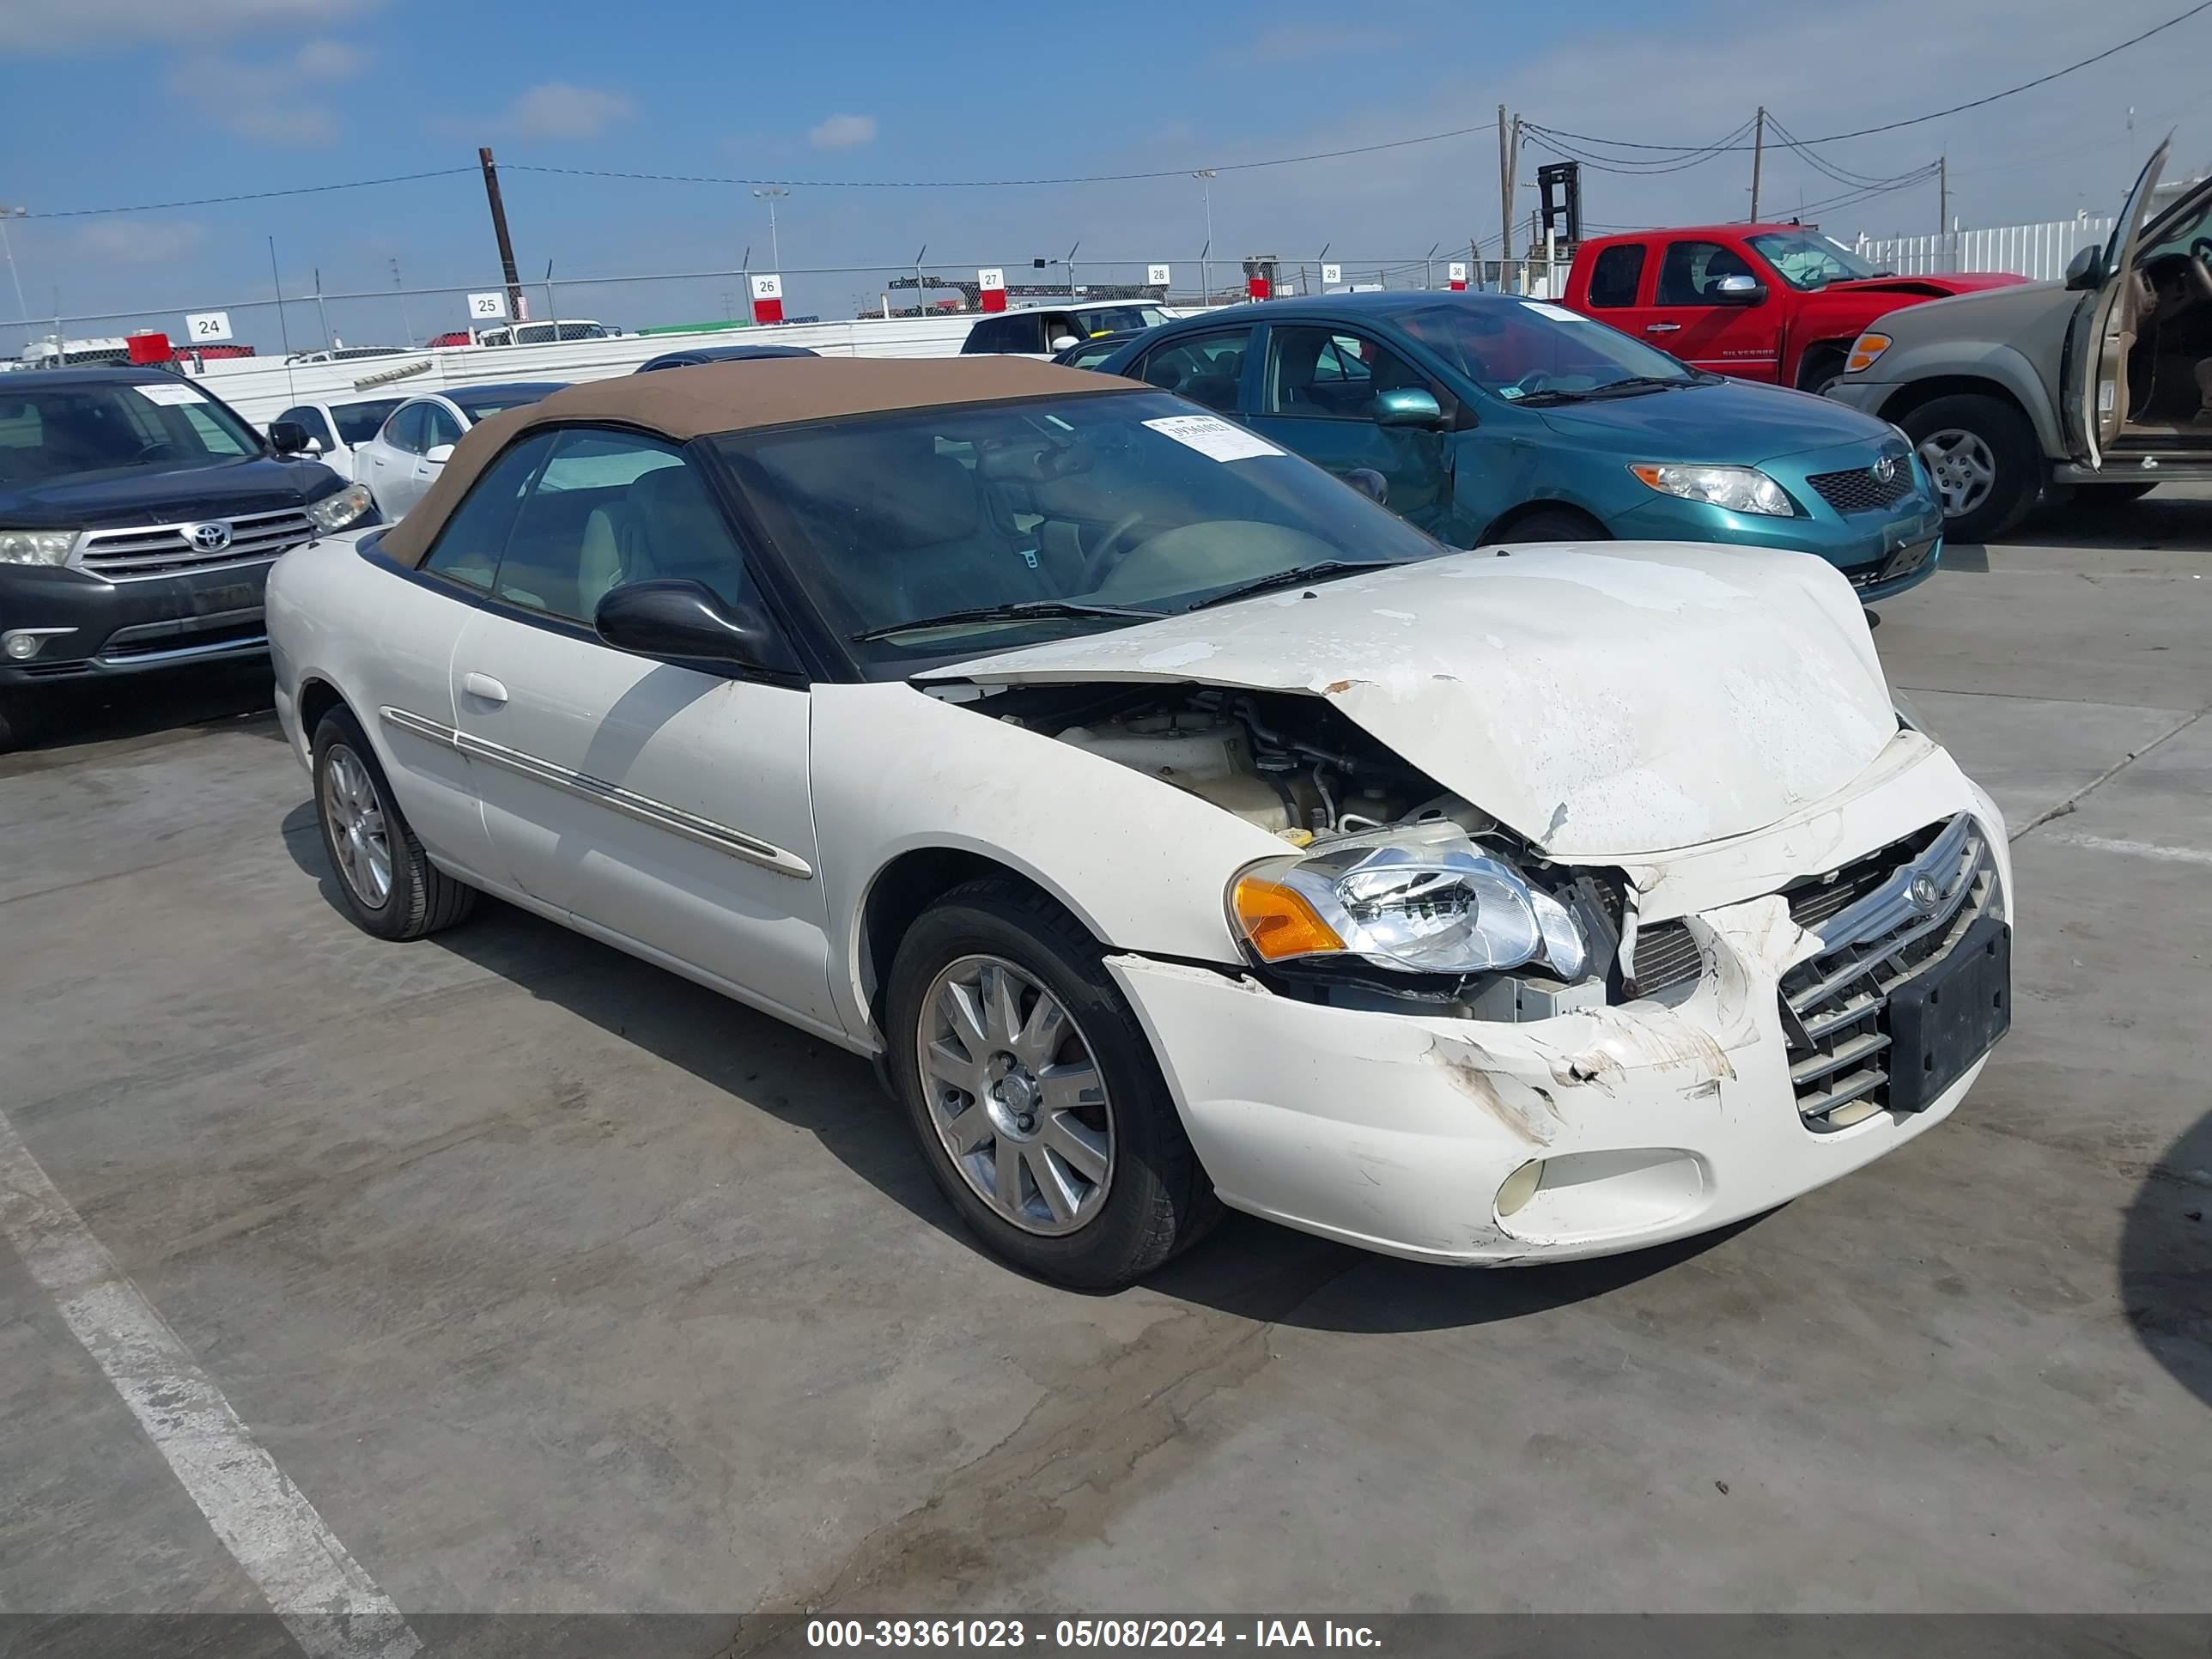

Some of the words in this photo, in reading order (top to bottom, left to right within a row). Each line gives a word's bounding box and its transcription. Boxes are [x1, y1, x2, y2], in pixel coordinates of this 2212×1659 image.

[1154, 270, 1164, 280] 28
[1327, 269, 1336, 279] 29
[1453, 267, 1462, 276] 30
[985, 274, 997, 285] 27
[760, 282, 775, 293] 26
[478, 299, 495, 312] 25
[199, 320, 220, 334] 24
[1168, 422, 1231, 438] 39361023
